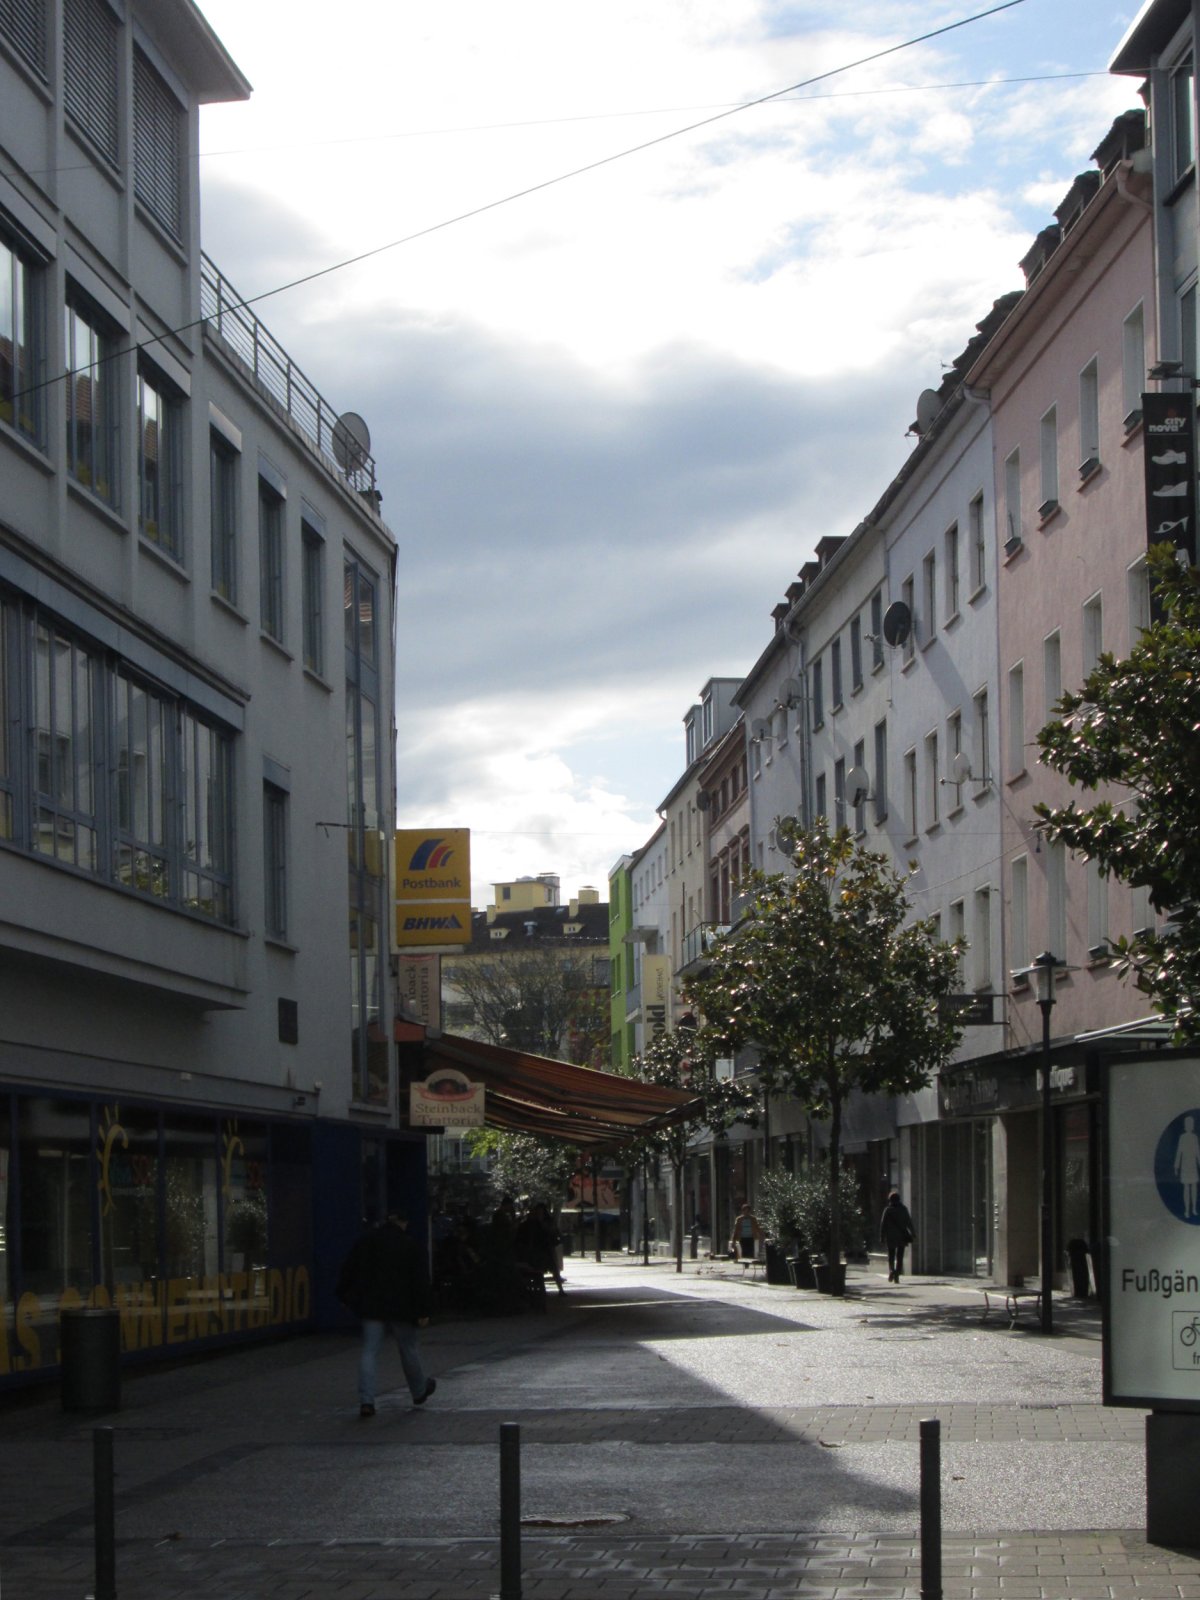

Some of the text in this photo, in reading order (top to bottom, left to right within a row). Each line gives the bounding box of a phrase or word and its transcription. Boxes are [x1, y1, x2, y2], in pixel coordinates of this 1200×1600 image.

[402, 877, 462, 890] Postbank
[1036, 1065, 1075, 1093] btique
[415, 1103, 481, 1114] Steinback
[417, 1114, 478, 1126] Trattoria
[1122, 1268, 1198, 1298] Fußgän
[56, 1265, 310, 1365] NNENSTUDIO
